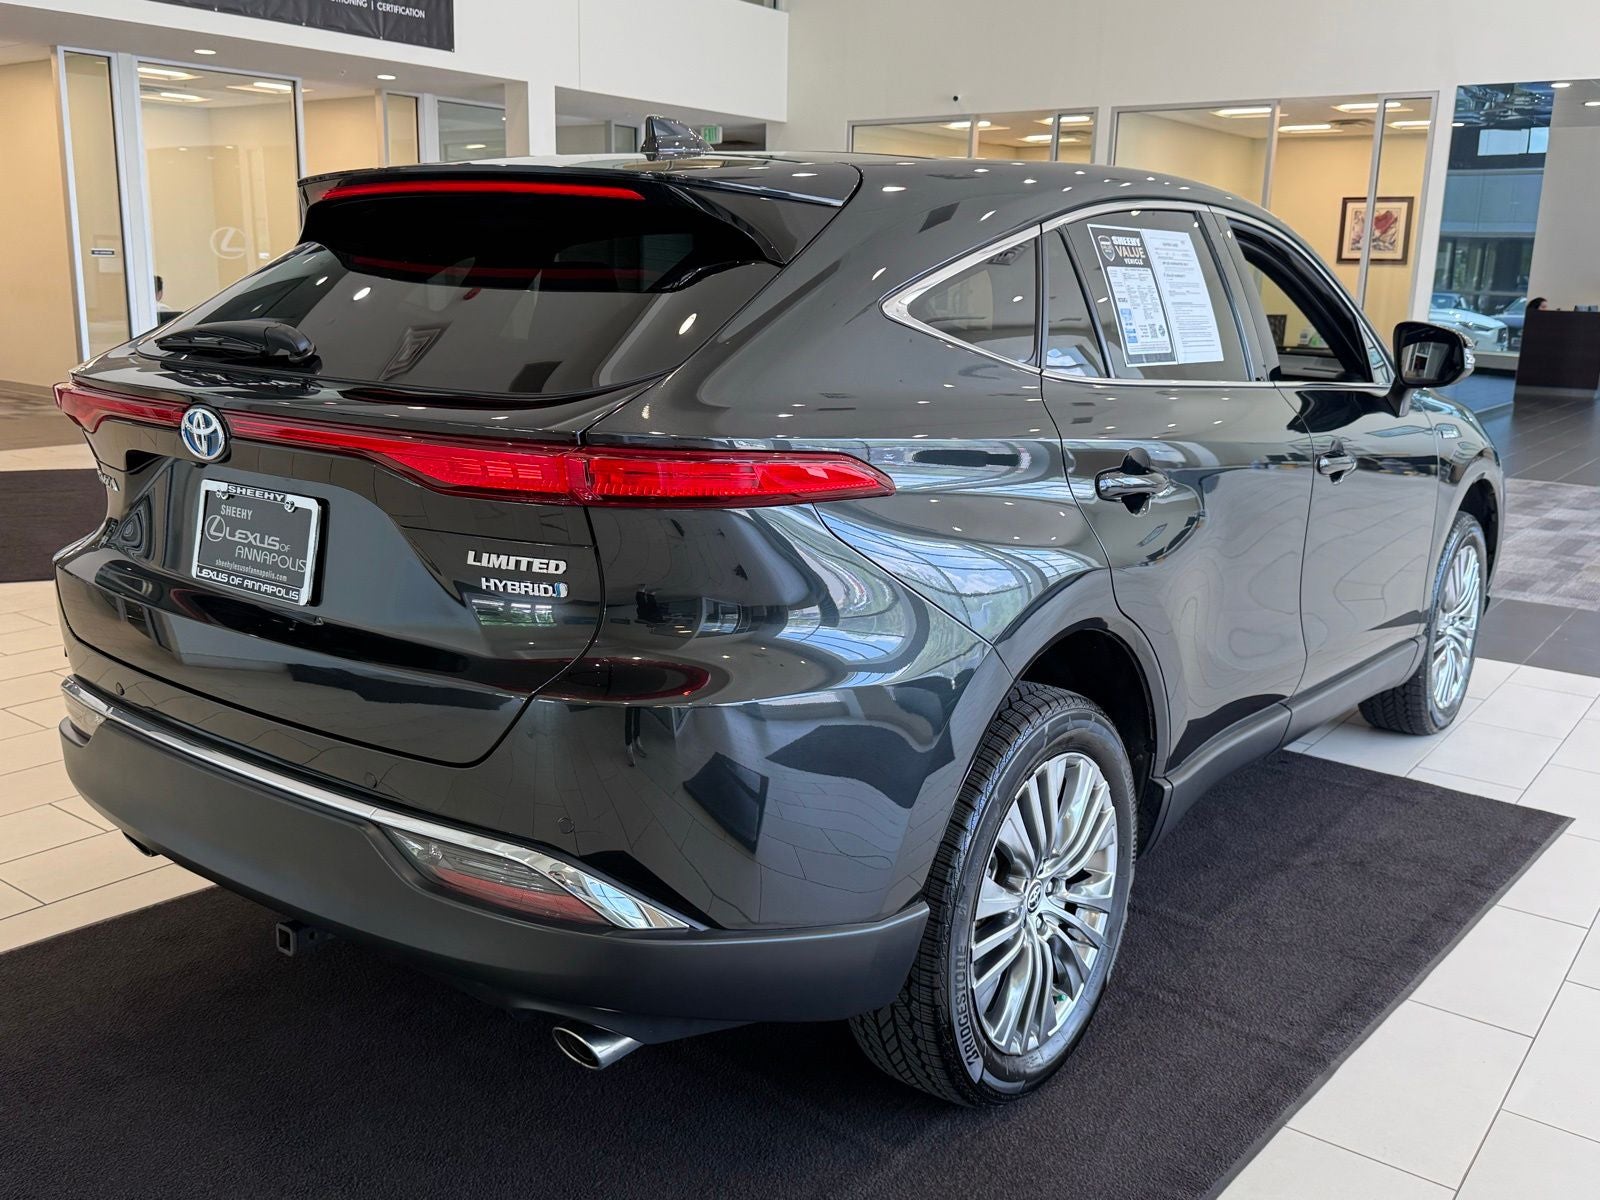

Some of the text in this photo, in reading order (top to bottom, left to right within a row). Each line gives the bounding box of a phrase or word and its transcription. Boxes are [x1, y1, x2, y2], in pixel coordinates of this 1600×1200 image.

[377, 2, 426, 19] CERTIFICATION
[1115, 246, 1146, 258] VALUE
[228, 484, 285, 502] SHEEHY
[221, 504, 253, 520] SHEEHY
[226, 526, 291, 553] LEXUS OF
[235, 545, 307, 573] ANNAPOLIS
[466, 550, 567, 575] LIMITED
[197, 567, 299, 601] LEXUS OF ANNAPOLIS
[481, 577, 553, 597] HYBRID
[955, 945, 980, 1066] BRIDGESTONE
